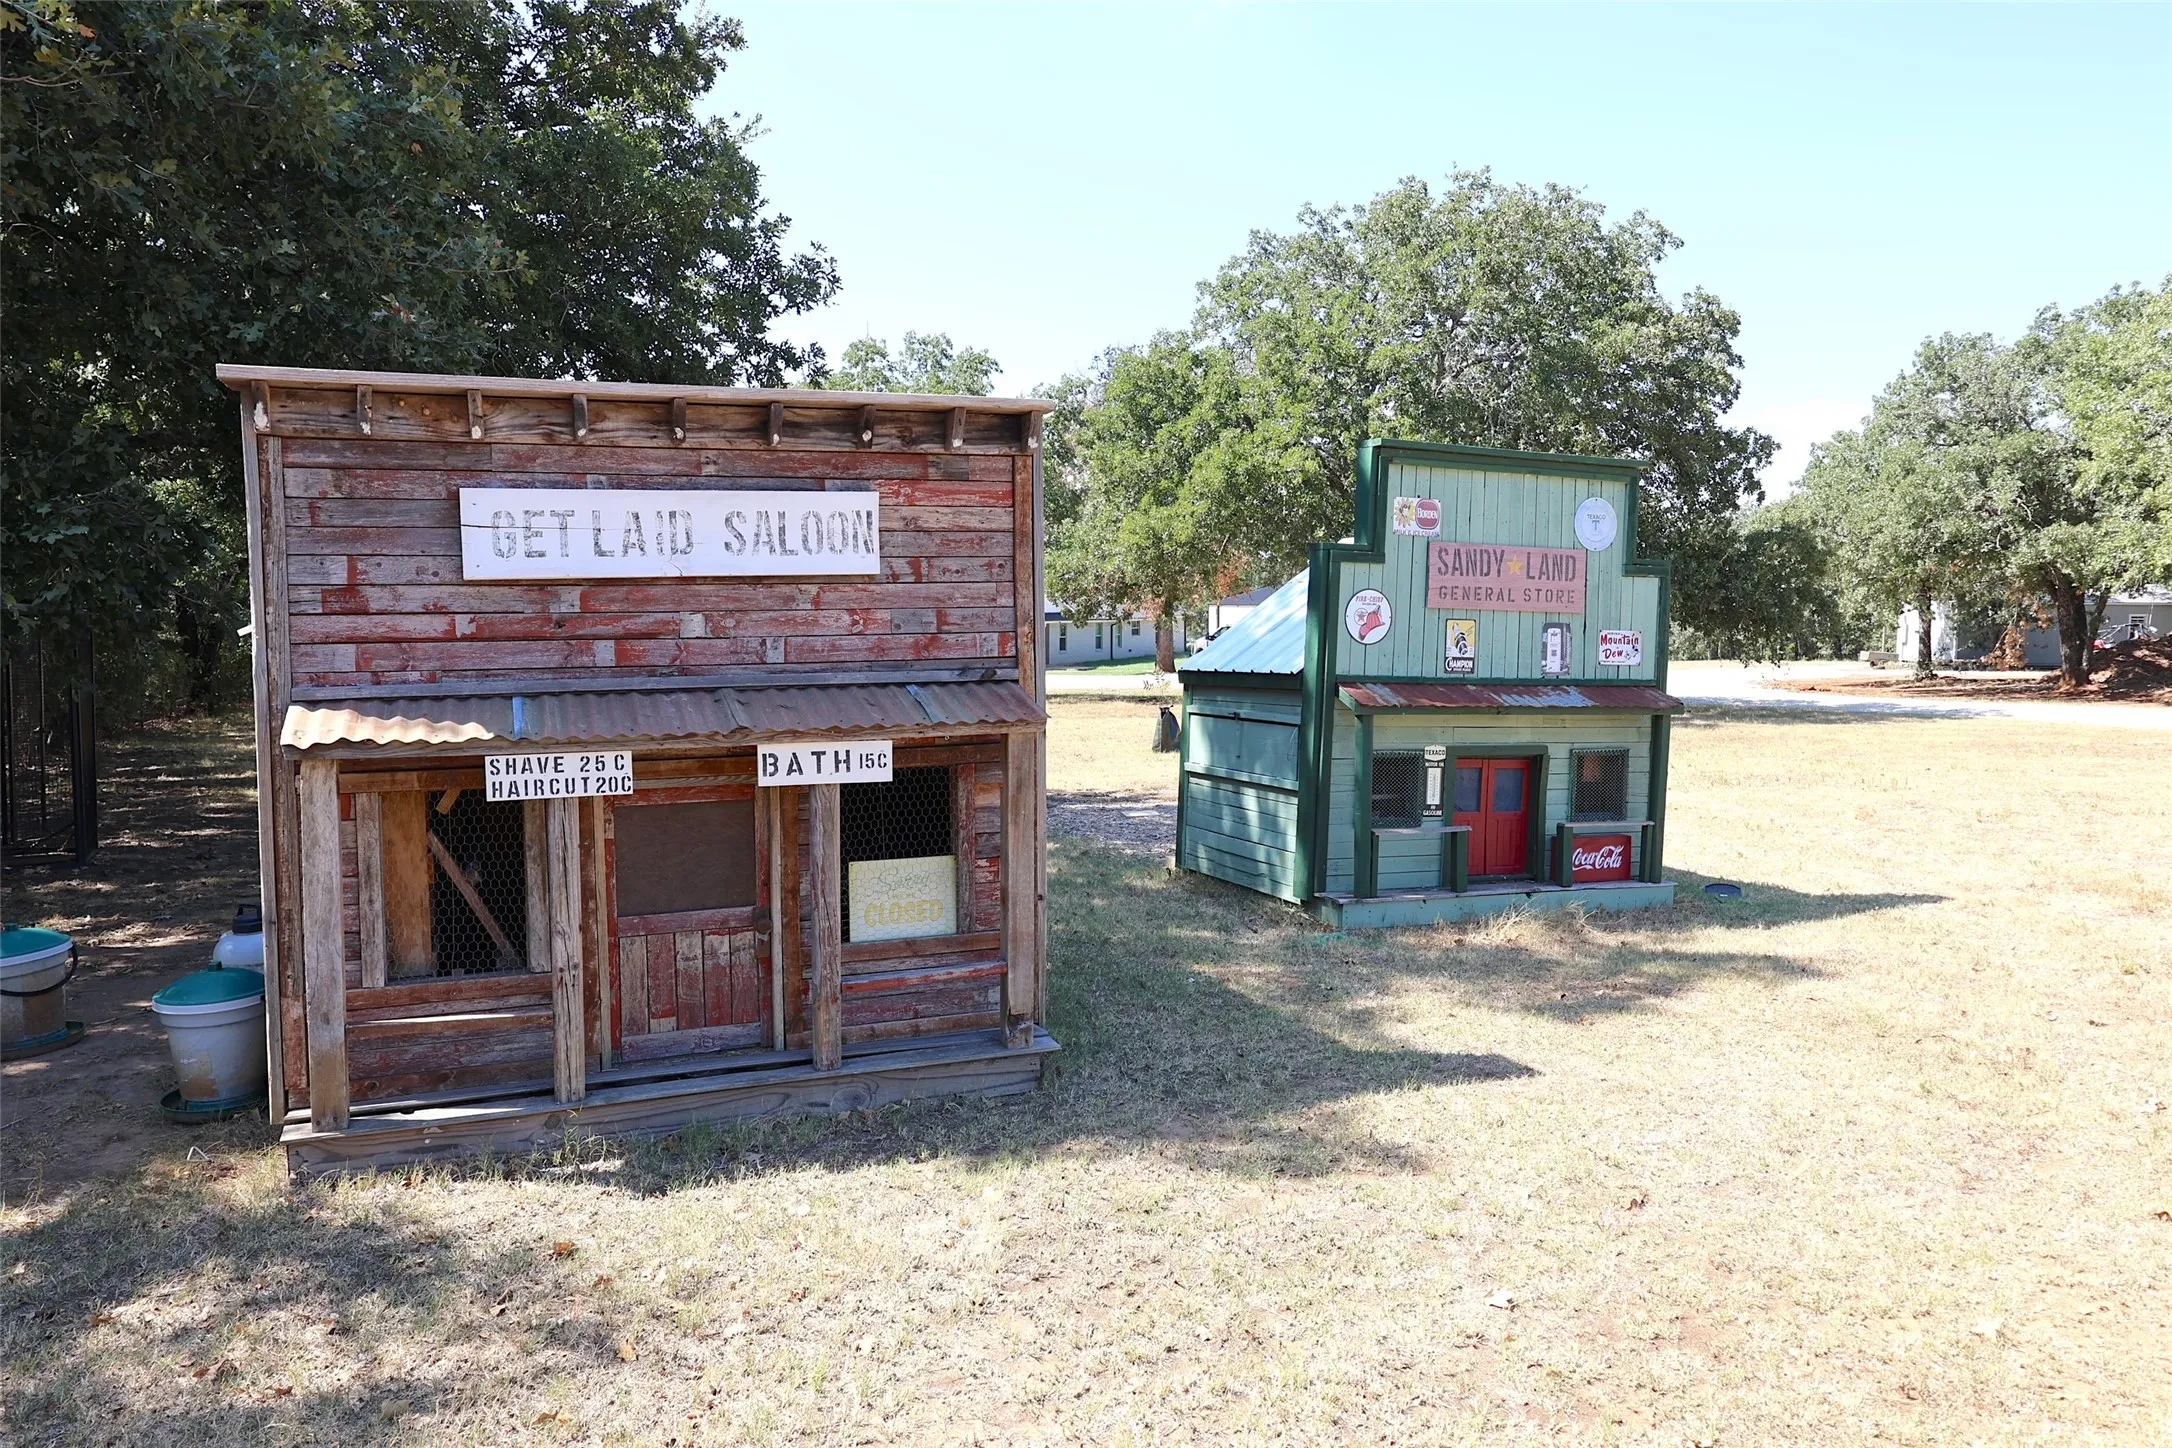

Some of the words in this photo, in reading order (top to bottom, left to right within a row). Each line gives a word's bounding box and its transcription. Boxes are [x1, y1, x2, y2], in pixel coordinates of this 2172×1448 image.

[489, 509, 576, 559] GET
[591, 509, 695, 558] LAID
[724, 509, 876, 558] SALOON
[1437, 546, 1506, 578] SANDY
[1525, 551, 1577, 582] LAND
[1438, 585, 1515, 603] GENERAL
[1523, 588, 1576, 604] STORE
[1600, 632, 1639, 646] Mountain
[1602, 648, 1624, 659] Dew
[489, 756, 565, 776] SHAVE
[761, 750, 851, 777] BATH
[491, 776, 590, 799] HAIRCUT
[864, 898, 945, 928] CLOSED
